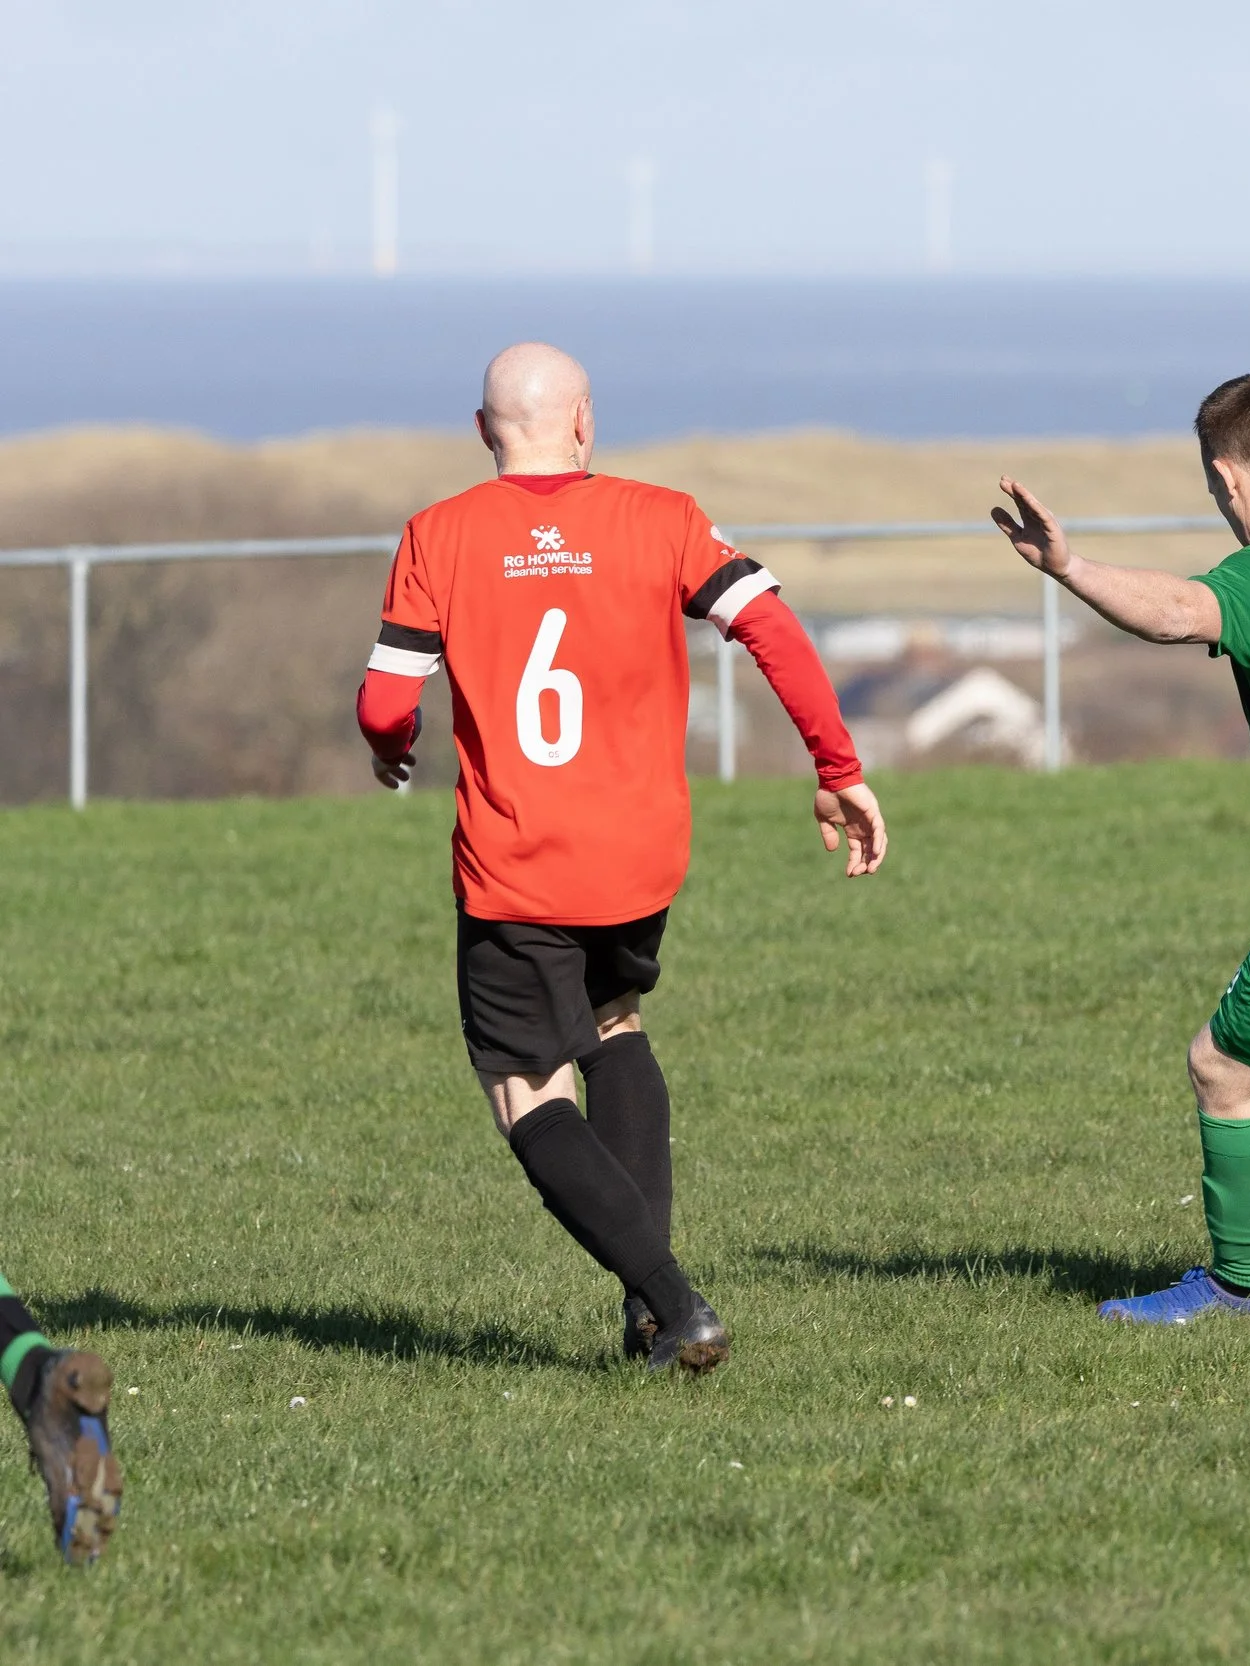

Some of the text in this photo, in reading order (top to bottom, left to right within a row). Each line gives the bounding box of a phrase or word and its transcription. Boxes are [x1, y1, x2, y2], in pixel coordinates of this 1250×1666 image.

[504, 552, 592, 567] RG HOWELLS
[504, 565, 592, 578] cleaning services
[516, 607, 583, 767] 6
